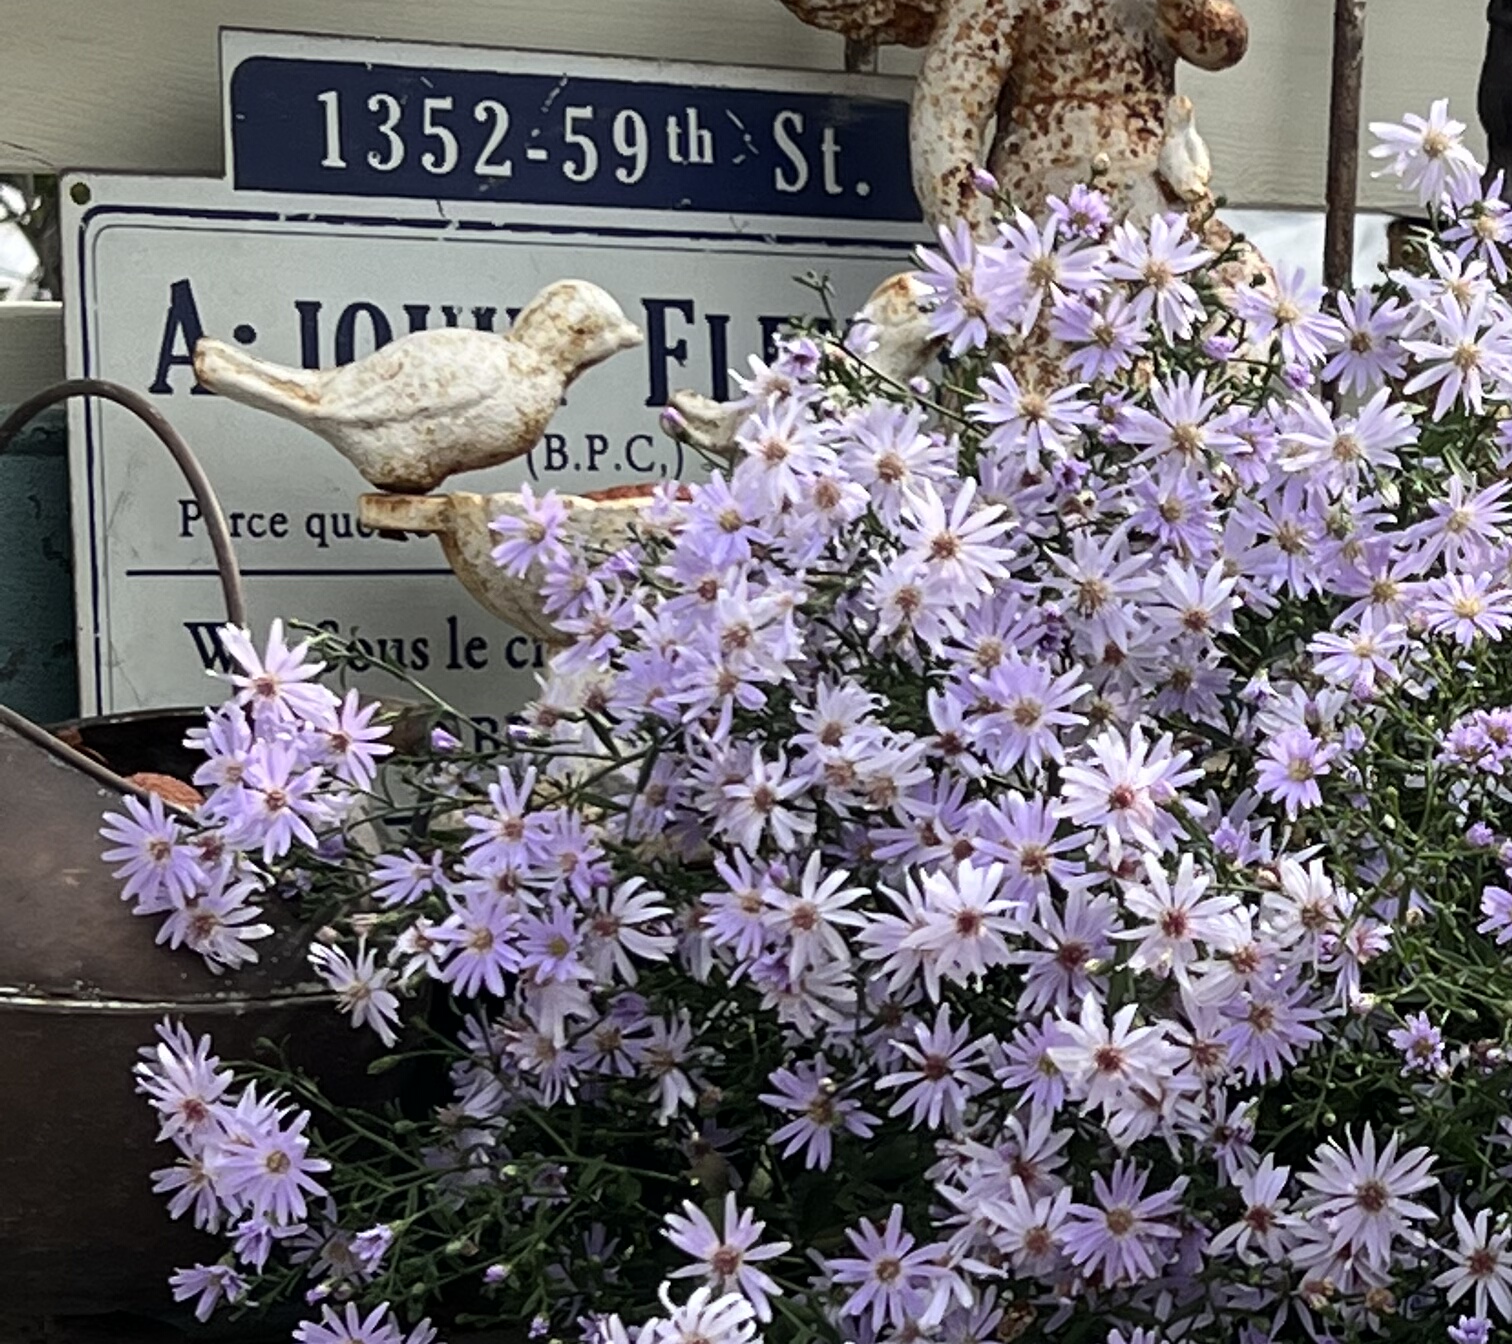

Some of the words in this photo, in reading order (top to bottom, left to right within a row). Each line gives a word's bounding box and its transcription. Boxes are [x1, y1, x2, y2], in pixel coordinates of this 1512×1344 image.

[772, 107, 872, 197] St.
[178, 499, 289, 538] Prce
[446, 615, 489, 670] le
